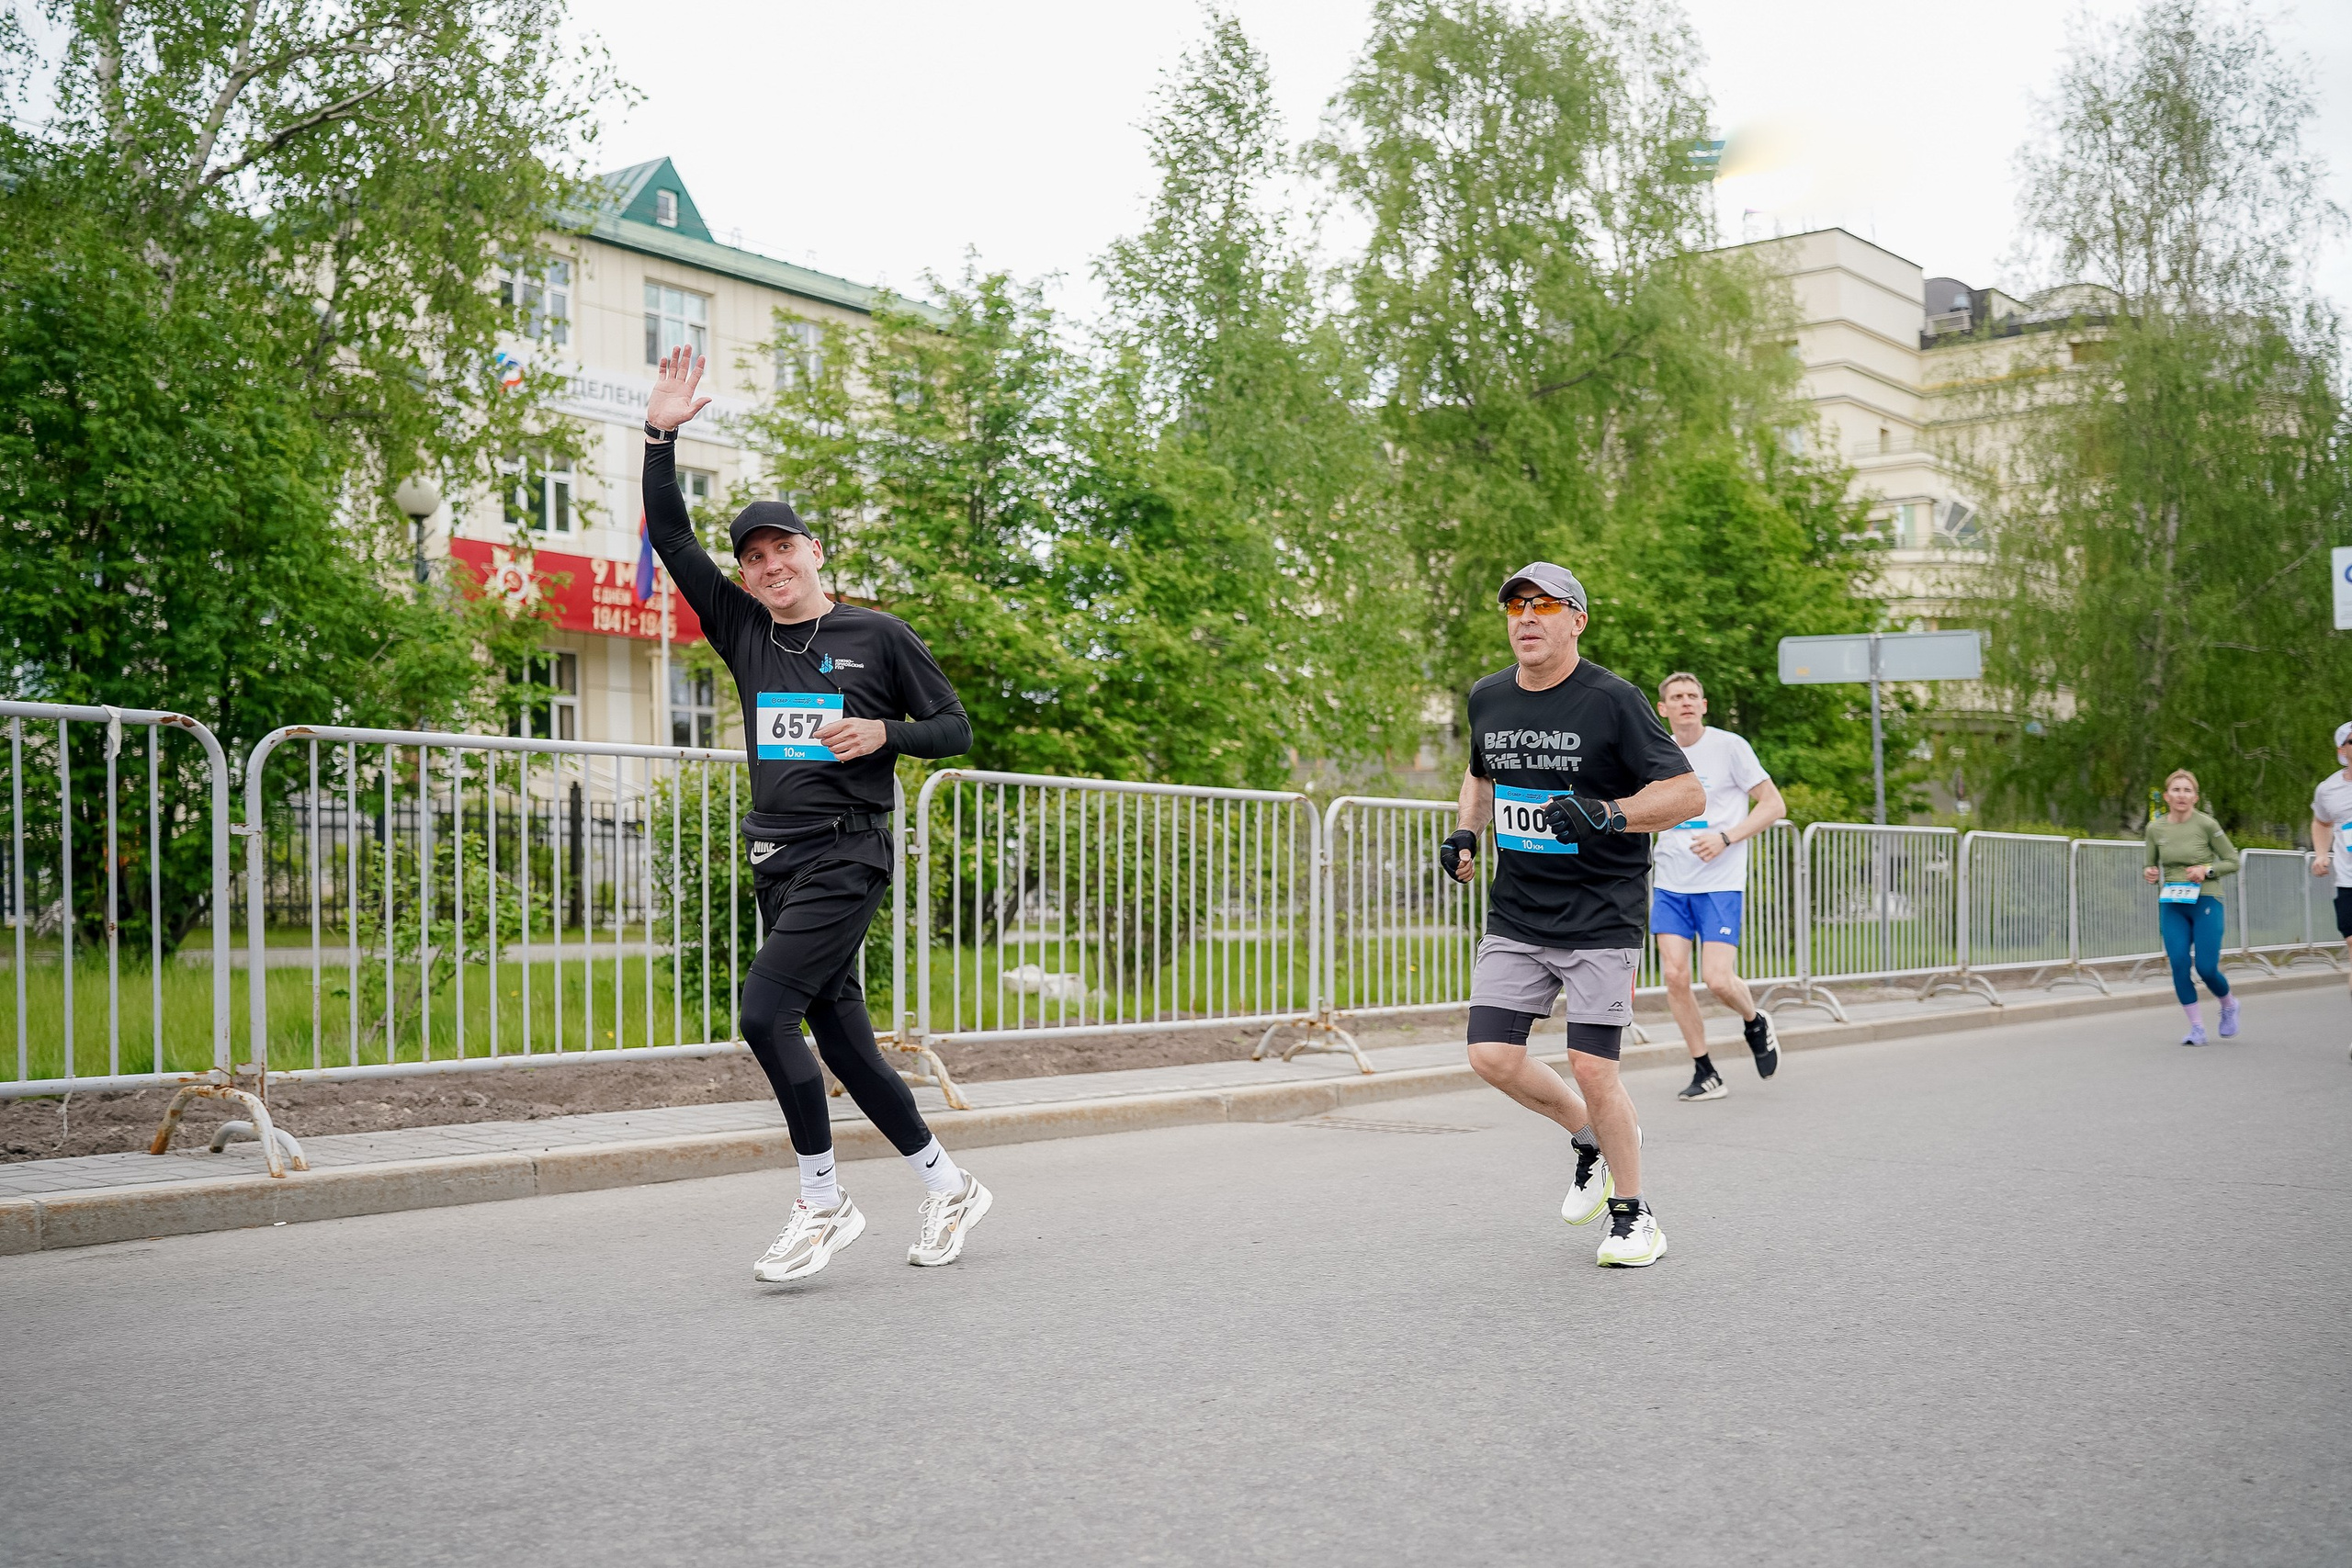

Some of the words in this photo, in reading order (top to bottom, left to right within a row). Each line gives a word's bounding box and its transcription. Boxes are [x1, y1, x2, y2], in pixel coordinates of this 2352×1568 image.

[591, 558, 609, 584] 9
[615, 561, 677, 595] МЯ
[772, 713, 823, 739] 657
[1484, 728, 1581, 750] BEYOND
[1486, 753, 1521, 770] THE
[1523, 753, 1582, 772] LIMIT
[1503, 805, 1548, 833] 100
[753, 840, 775, 853] NIKE
